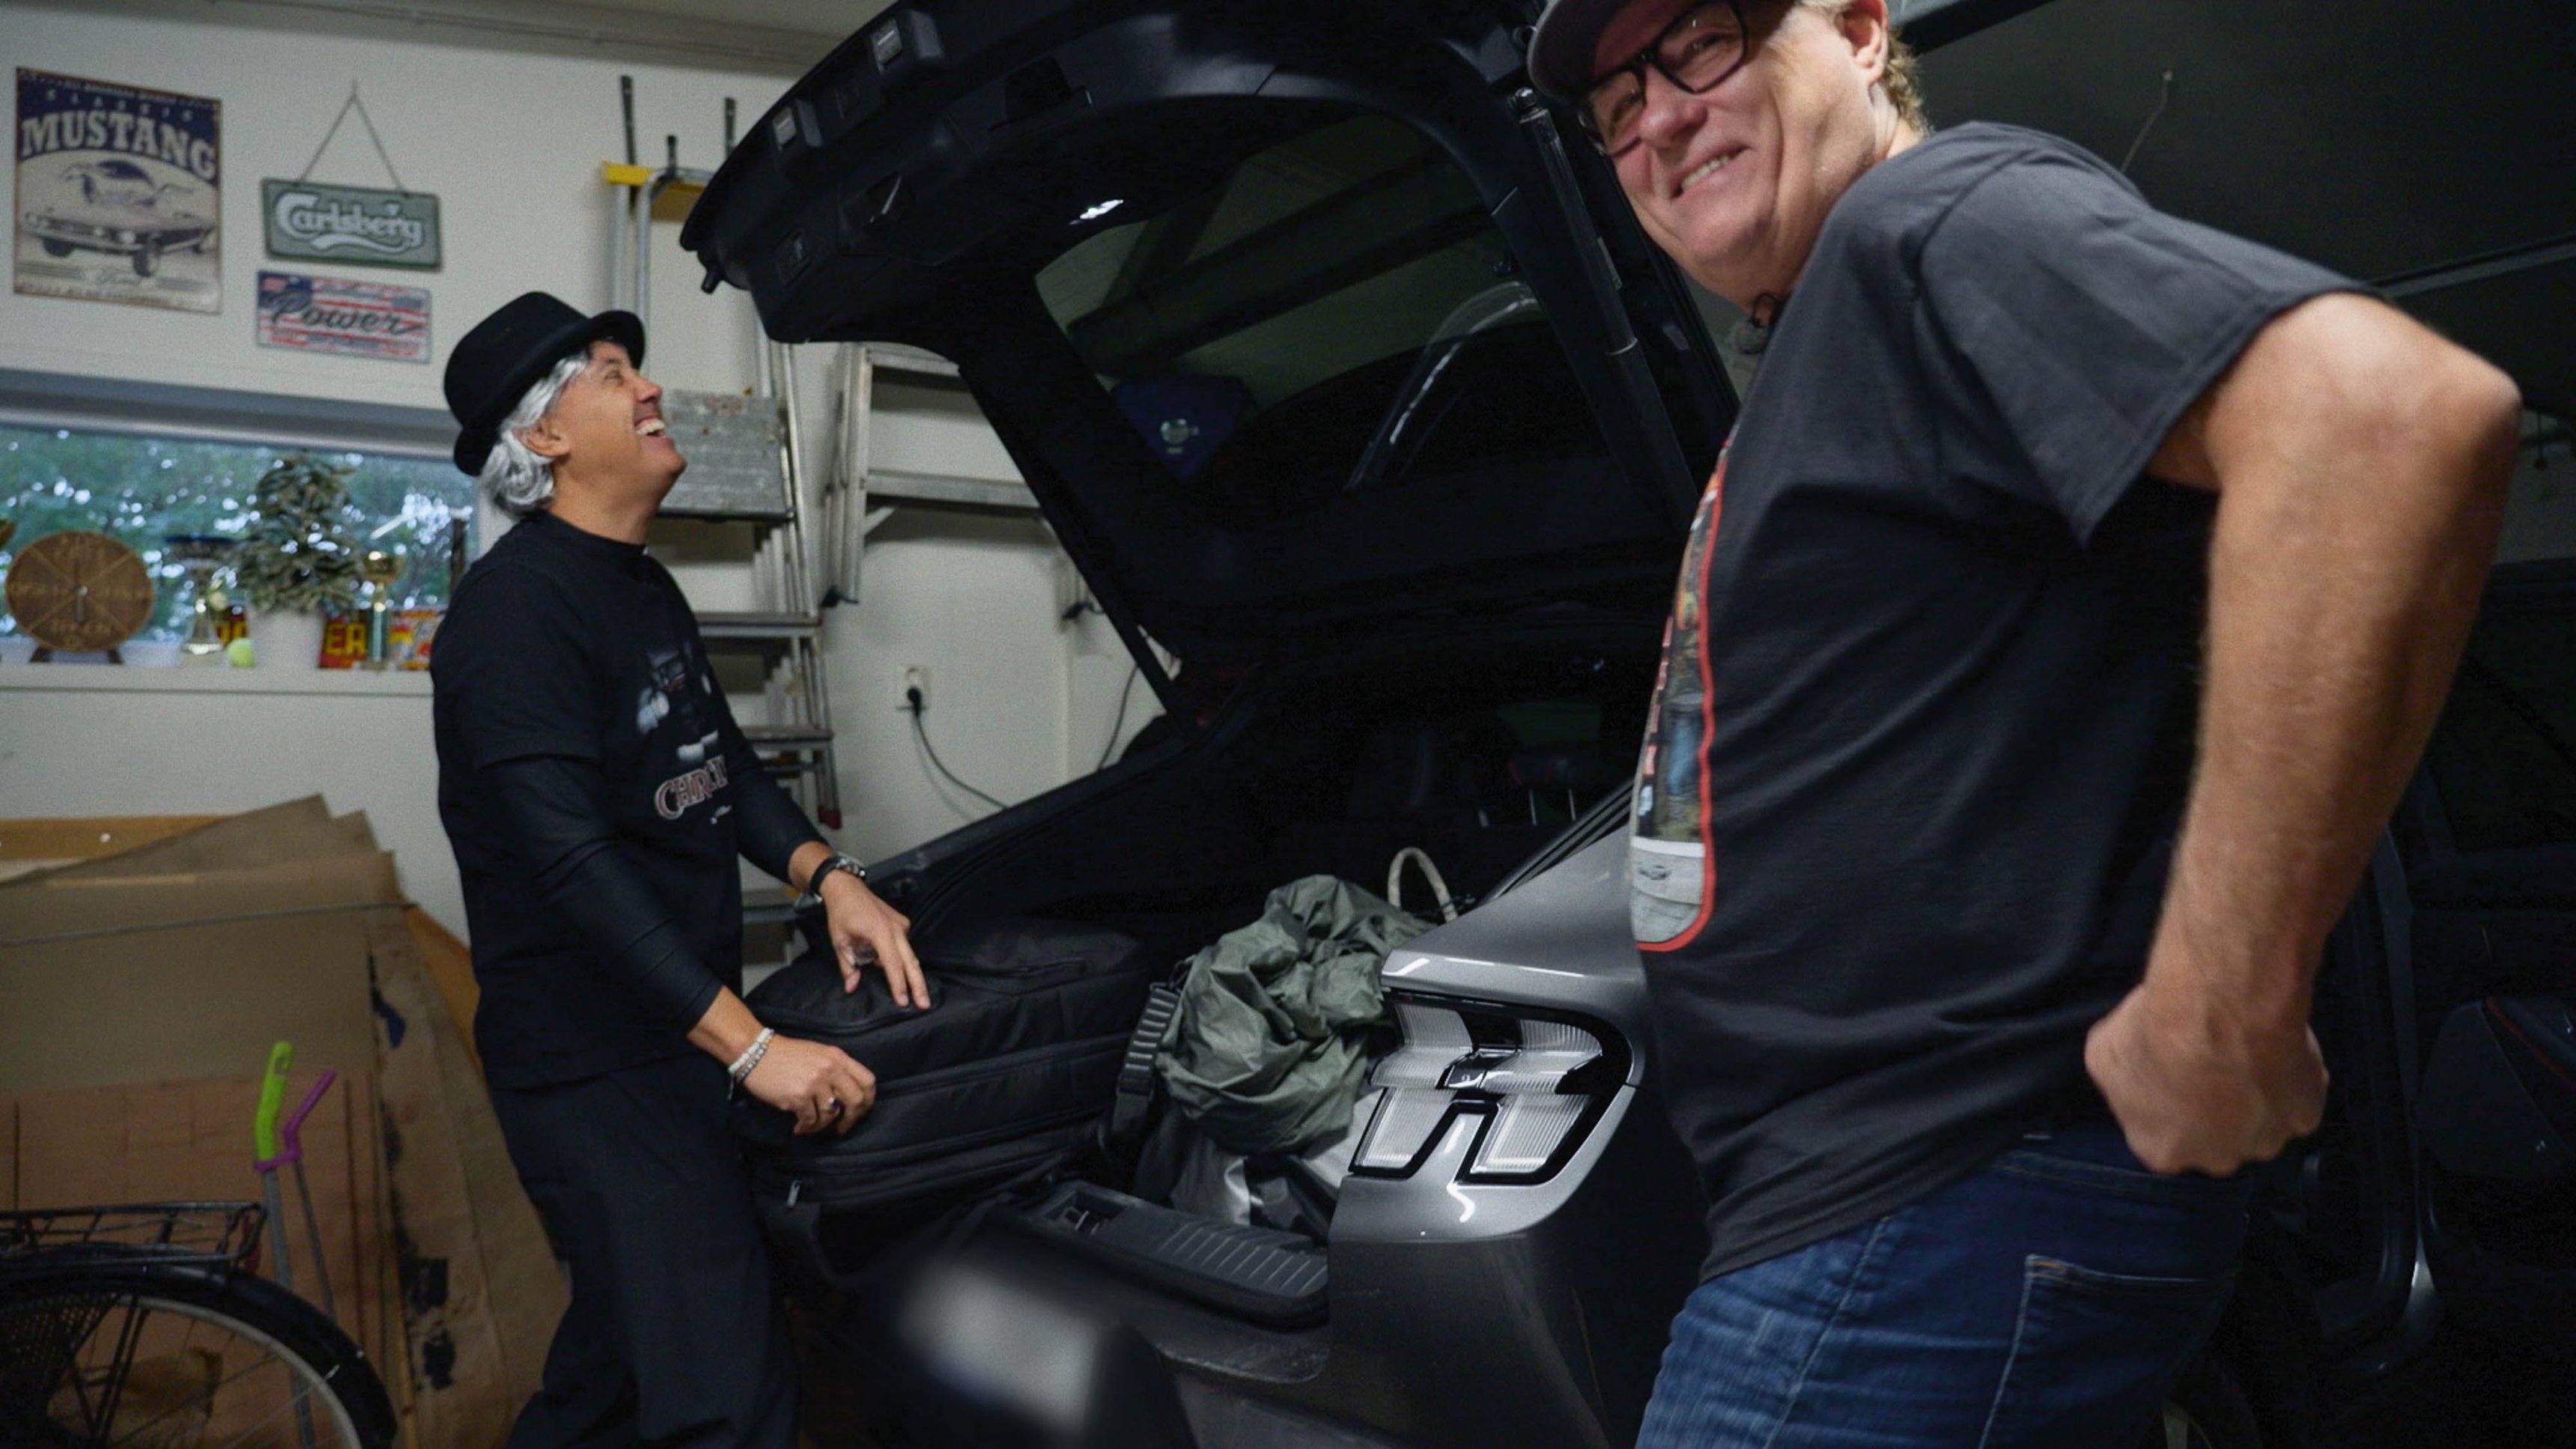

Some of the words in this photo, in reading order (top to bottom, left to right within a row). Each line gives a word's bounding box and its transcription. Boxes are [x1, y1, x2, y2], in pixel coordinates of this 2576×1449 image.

[20, 109, 218, 181] MUSTANG
[276, 192, 423, 253] Carlsberg
[267, 290, 425, 336] Power
